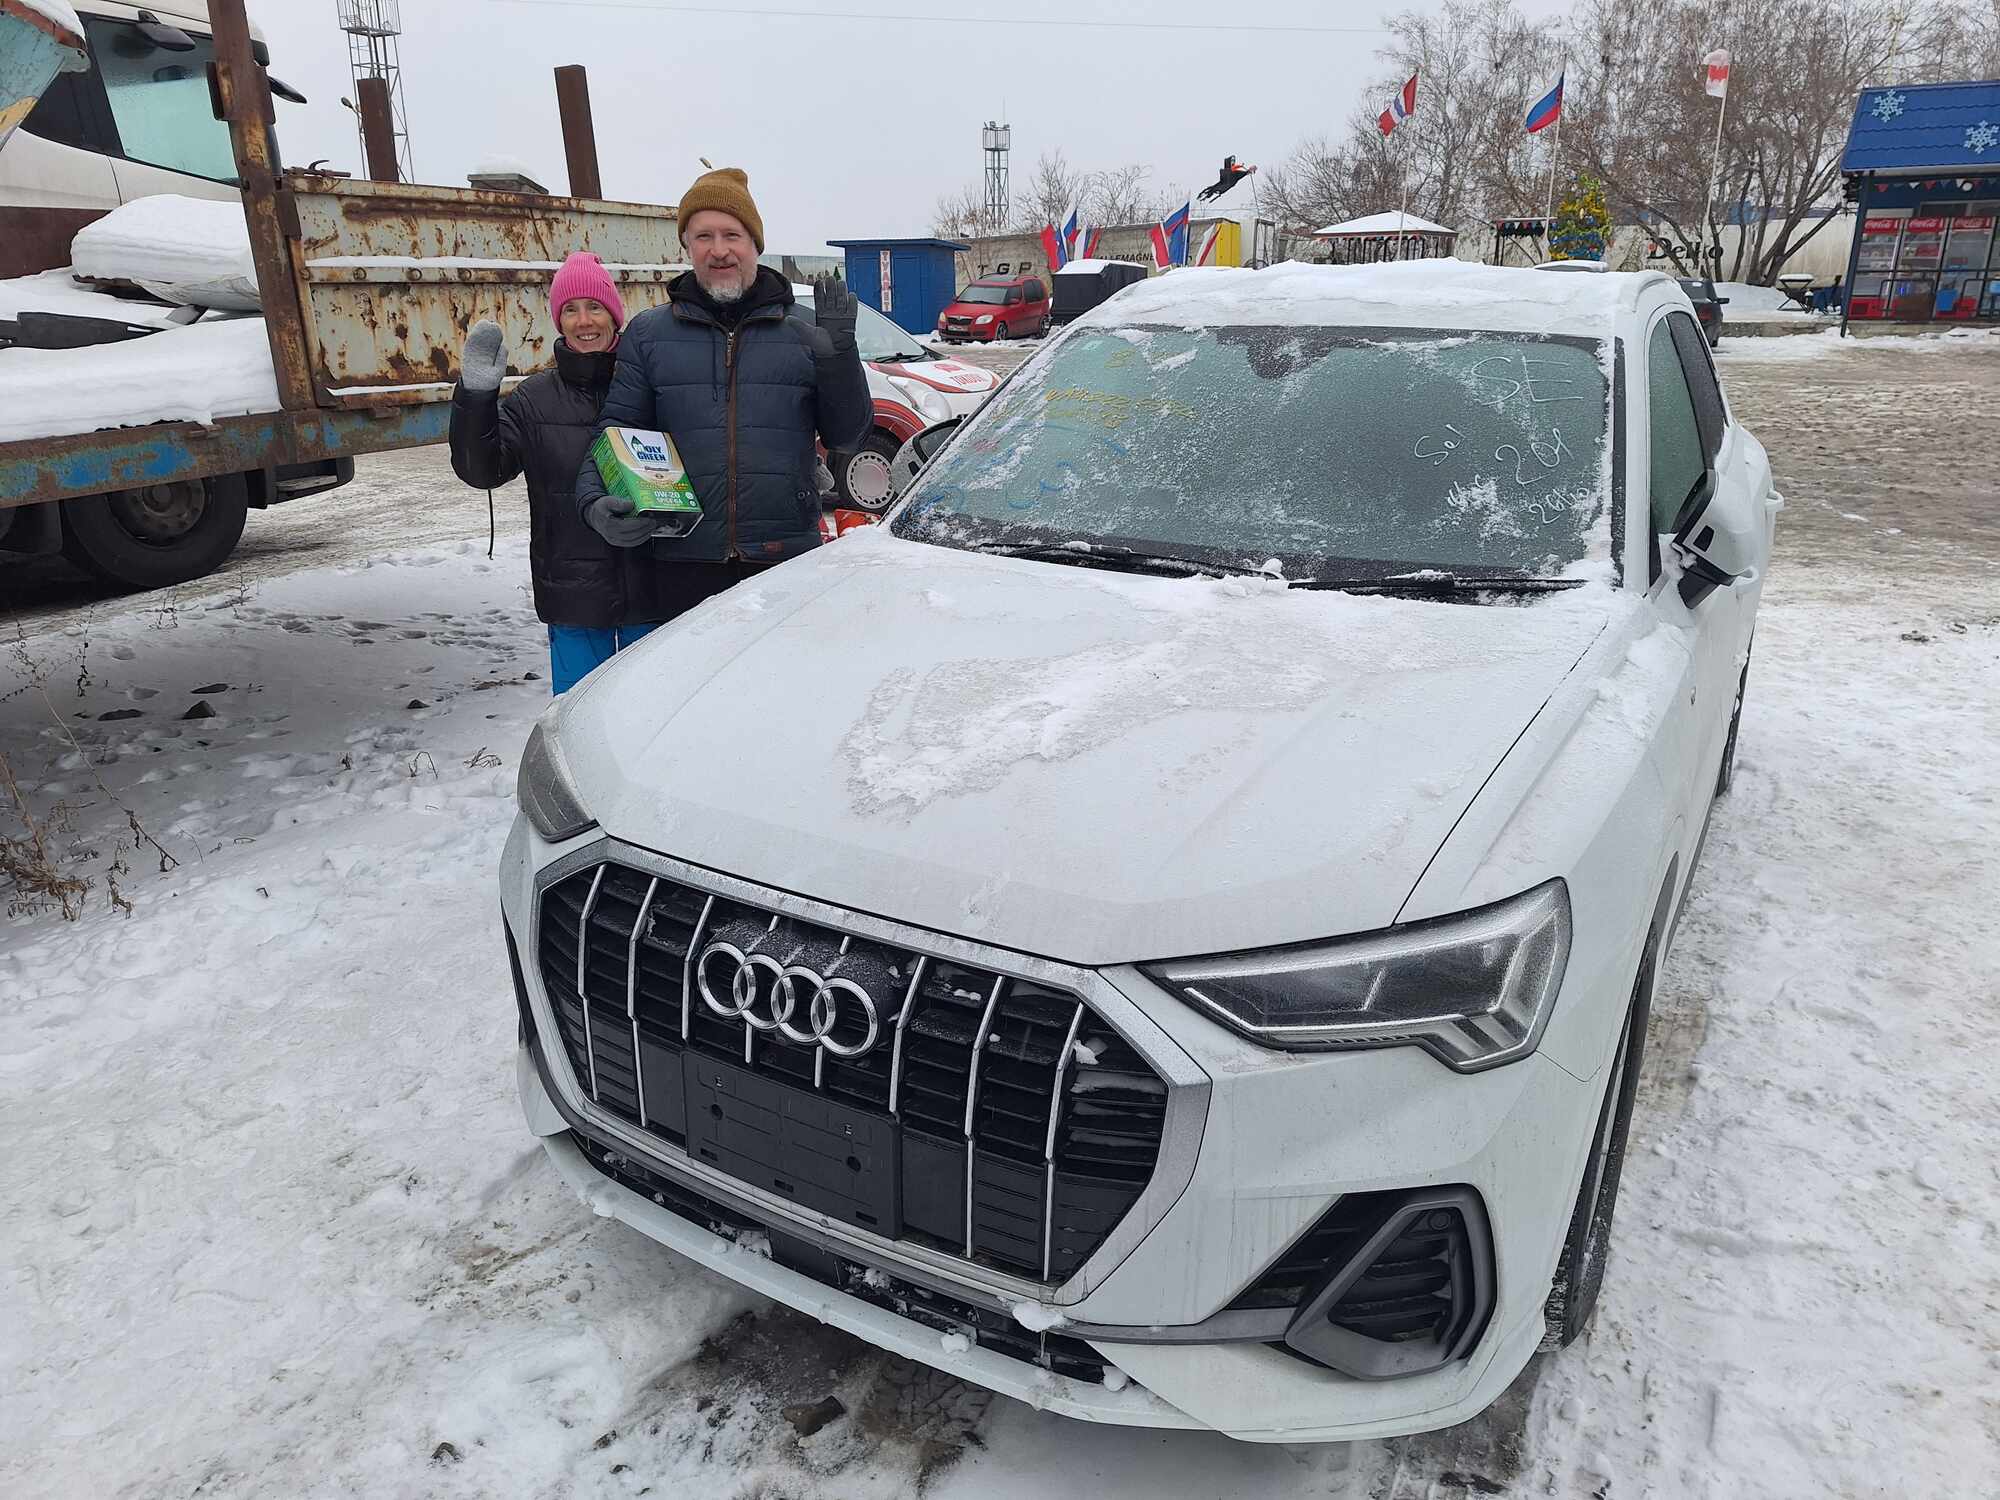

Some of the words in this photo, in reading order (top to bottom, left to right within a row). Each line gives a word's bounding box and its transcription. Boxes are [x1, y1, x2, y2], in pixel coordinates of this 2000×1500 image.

[1470, 355, 1584, 406] SE
[637, 451, 666, 461] GREEN
[654, 490, 681, 499] 0W-20
